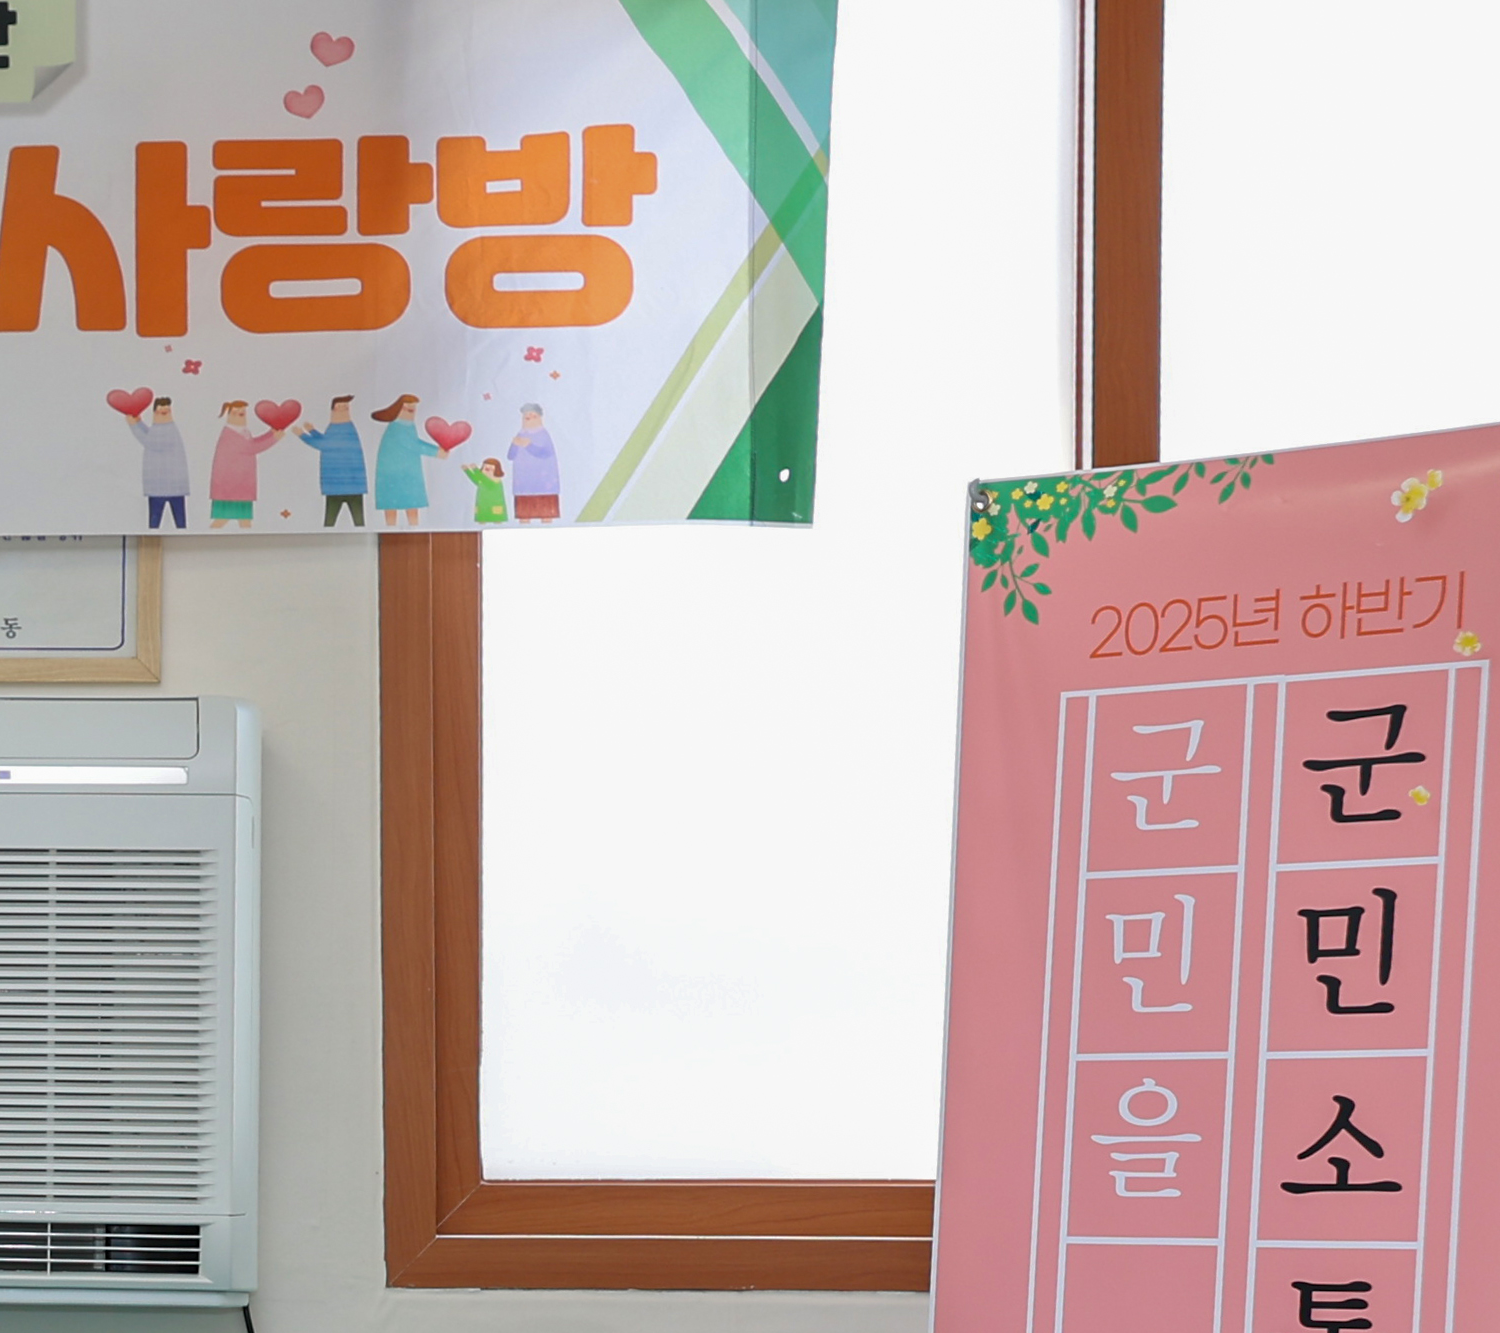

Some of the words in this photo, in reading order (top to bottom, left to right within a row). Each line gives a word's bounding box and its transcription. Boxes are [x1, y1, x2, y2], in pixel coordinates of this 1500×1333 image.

[1088, 586, 1281, 661] 2025년
[1299, 569, 1467, 641] 하반기
[1090, 718, 1222, 1198] 군민을
